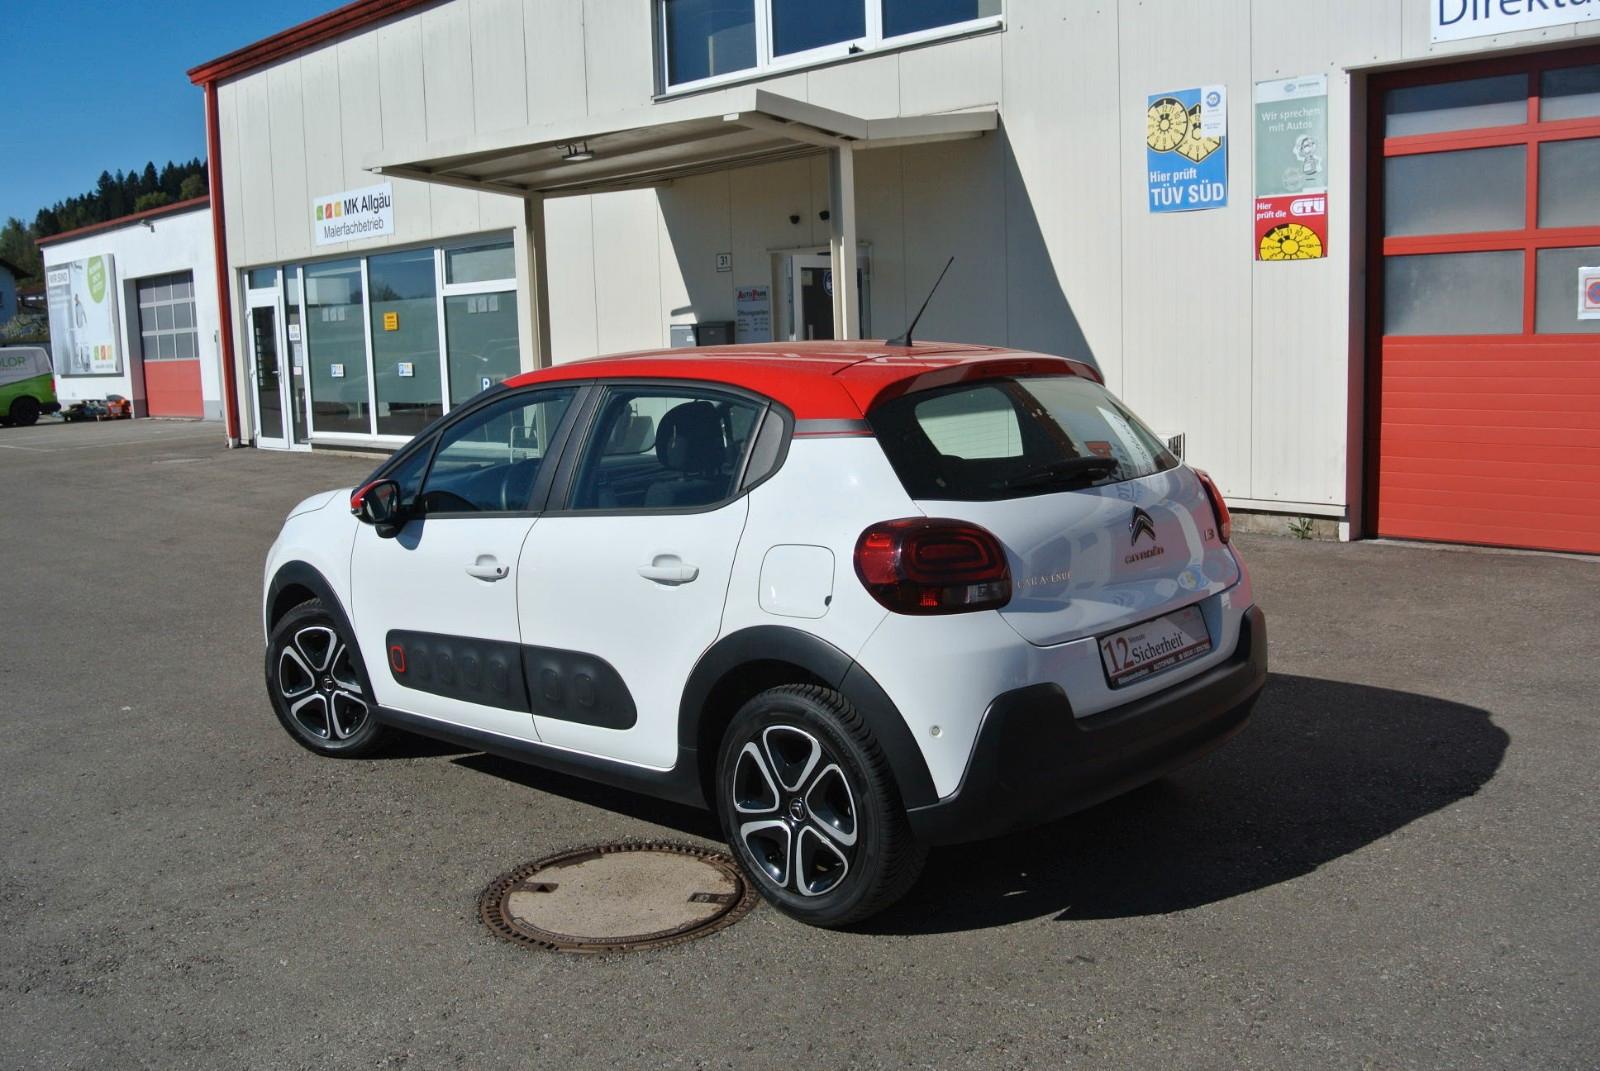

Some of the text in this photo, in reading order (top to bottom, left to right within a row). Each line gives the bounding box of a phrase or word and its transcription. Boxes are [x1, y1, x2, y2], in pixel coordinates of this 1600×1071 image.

[1261, 111, 1278, 121] Wir
[1150, 167, 1197, 184] Hier prüft
[1151, 179, 1224, 206] TÜV SÜD
[344, 192, 391, 216] MK Allgäu
[1257, 202, 1272, 211] Hier
[1256, 210, 1287, 222] prüft die
[324, 218, 384, 239] Malerfachbetrieb
[720, 255, 729, 266] 31
[0, 356, 26, 368] LOR
[1103, 637, 1135, 674] 12
[1132, 632, 1184, 663] Sicherheit
